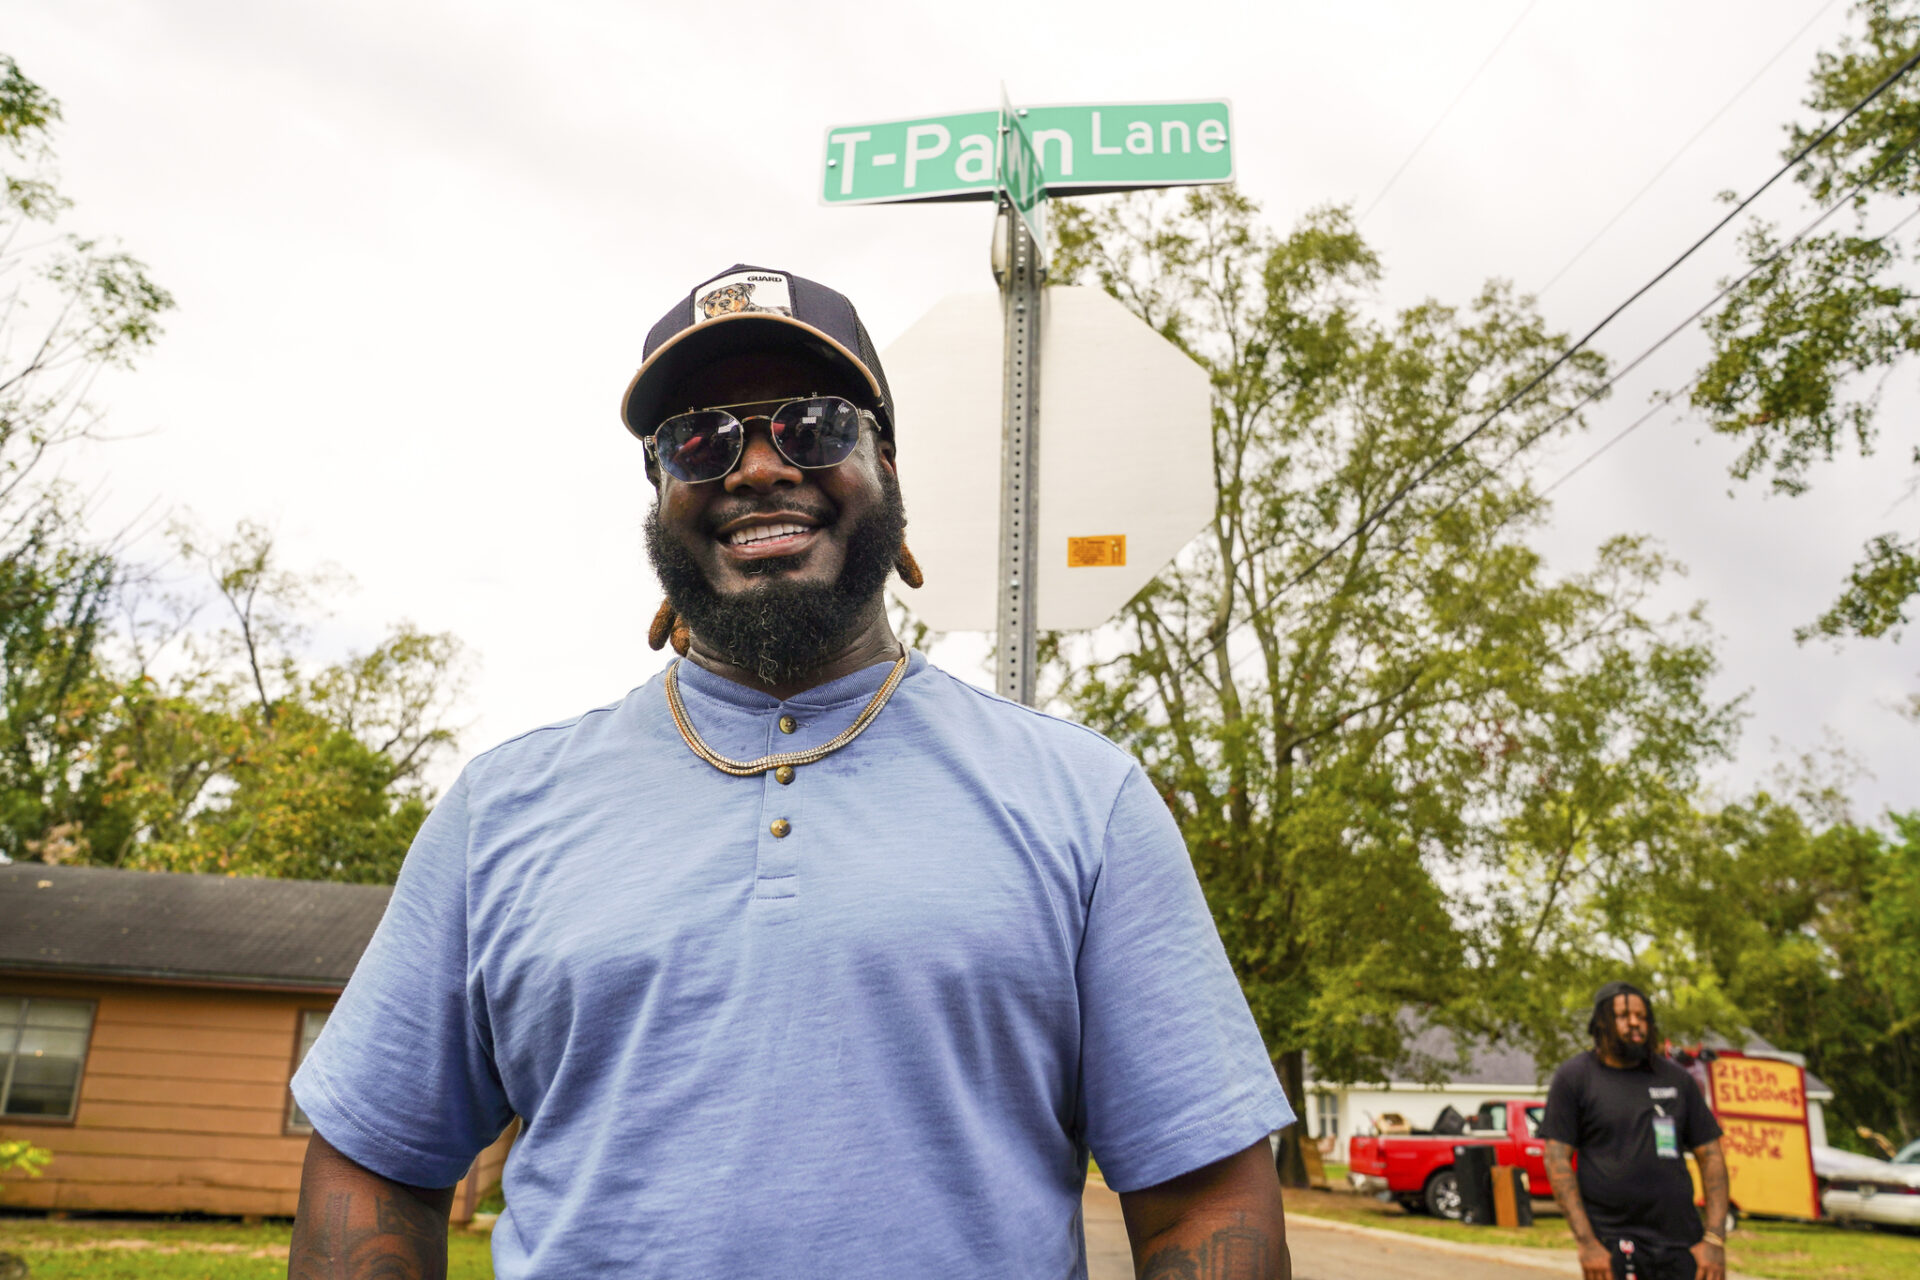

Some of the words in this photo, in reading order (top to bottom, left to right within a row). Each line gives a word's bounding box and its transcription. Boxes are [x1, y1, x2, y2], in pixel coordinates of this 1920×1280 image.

[830, 122, 1074, 196] T-Pan
[1091, 111, 1227, 156] Lane
[747, 275, 783, 283] GUARD
